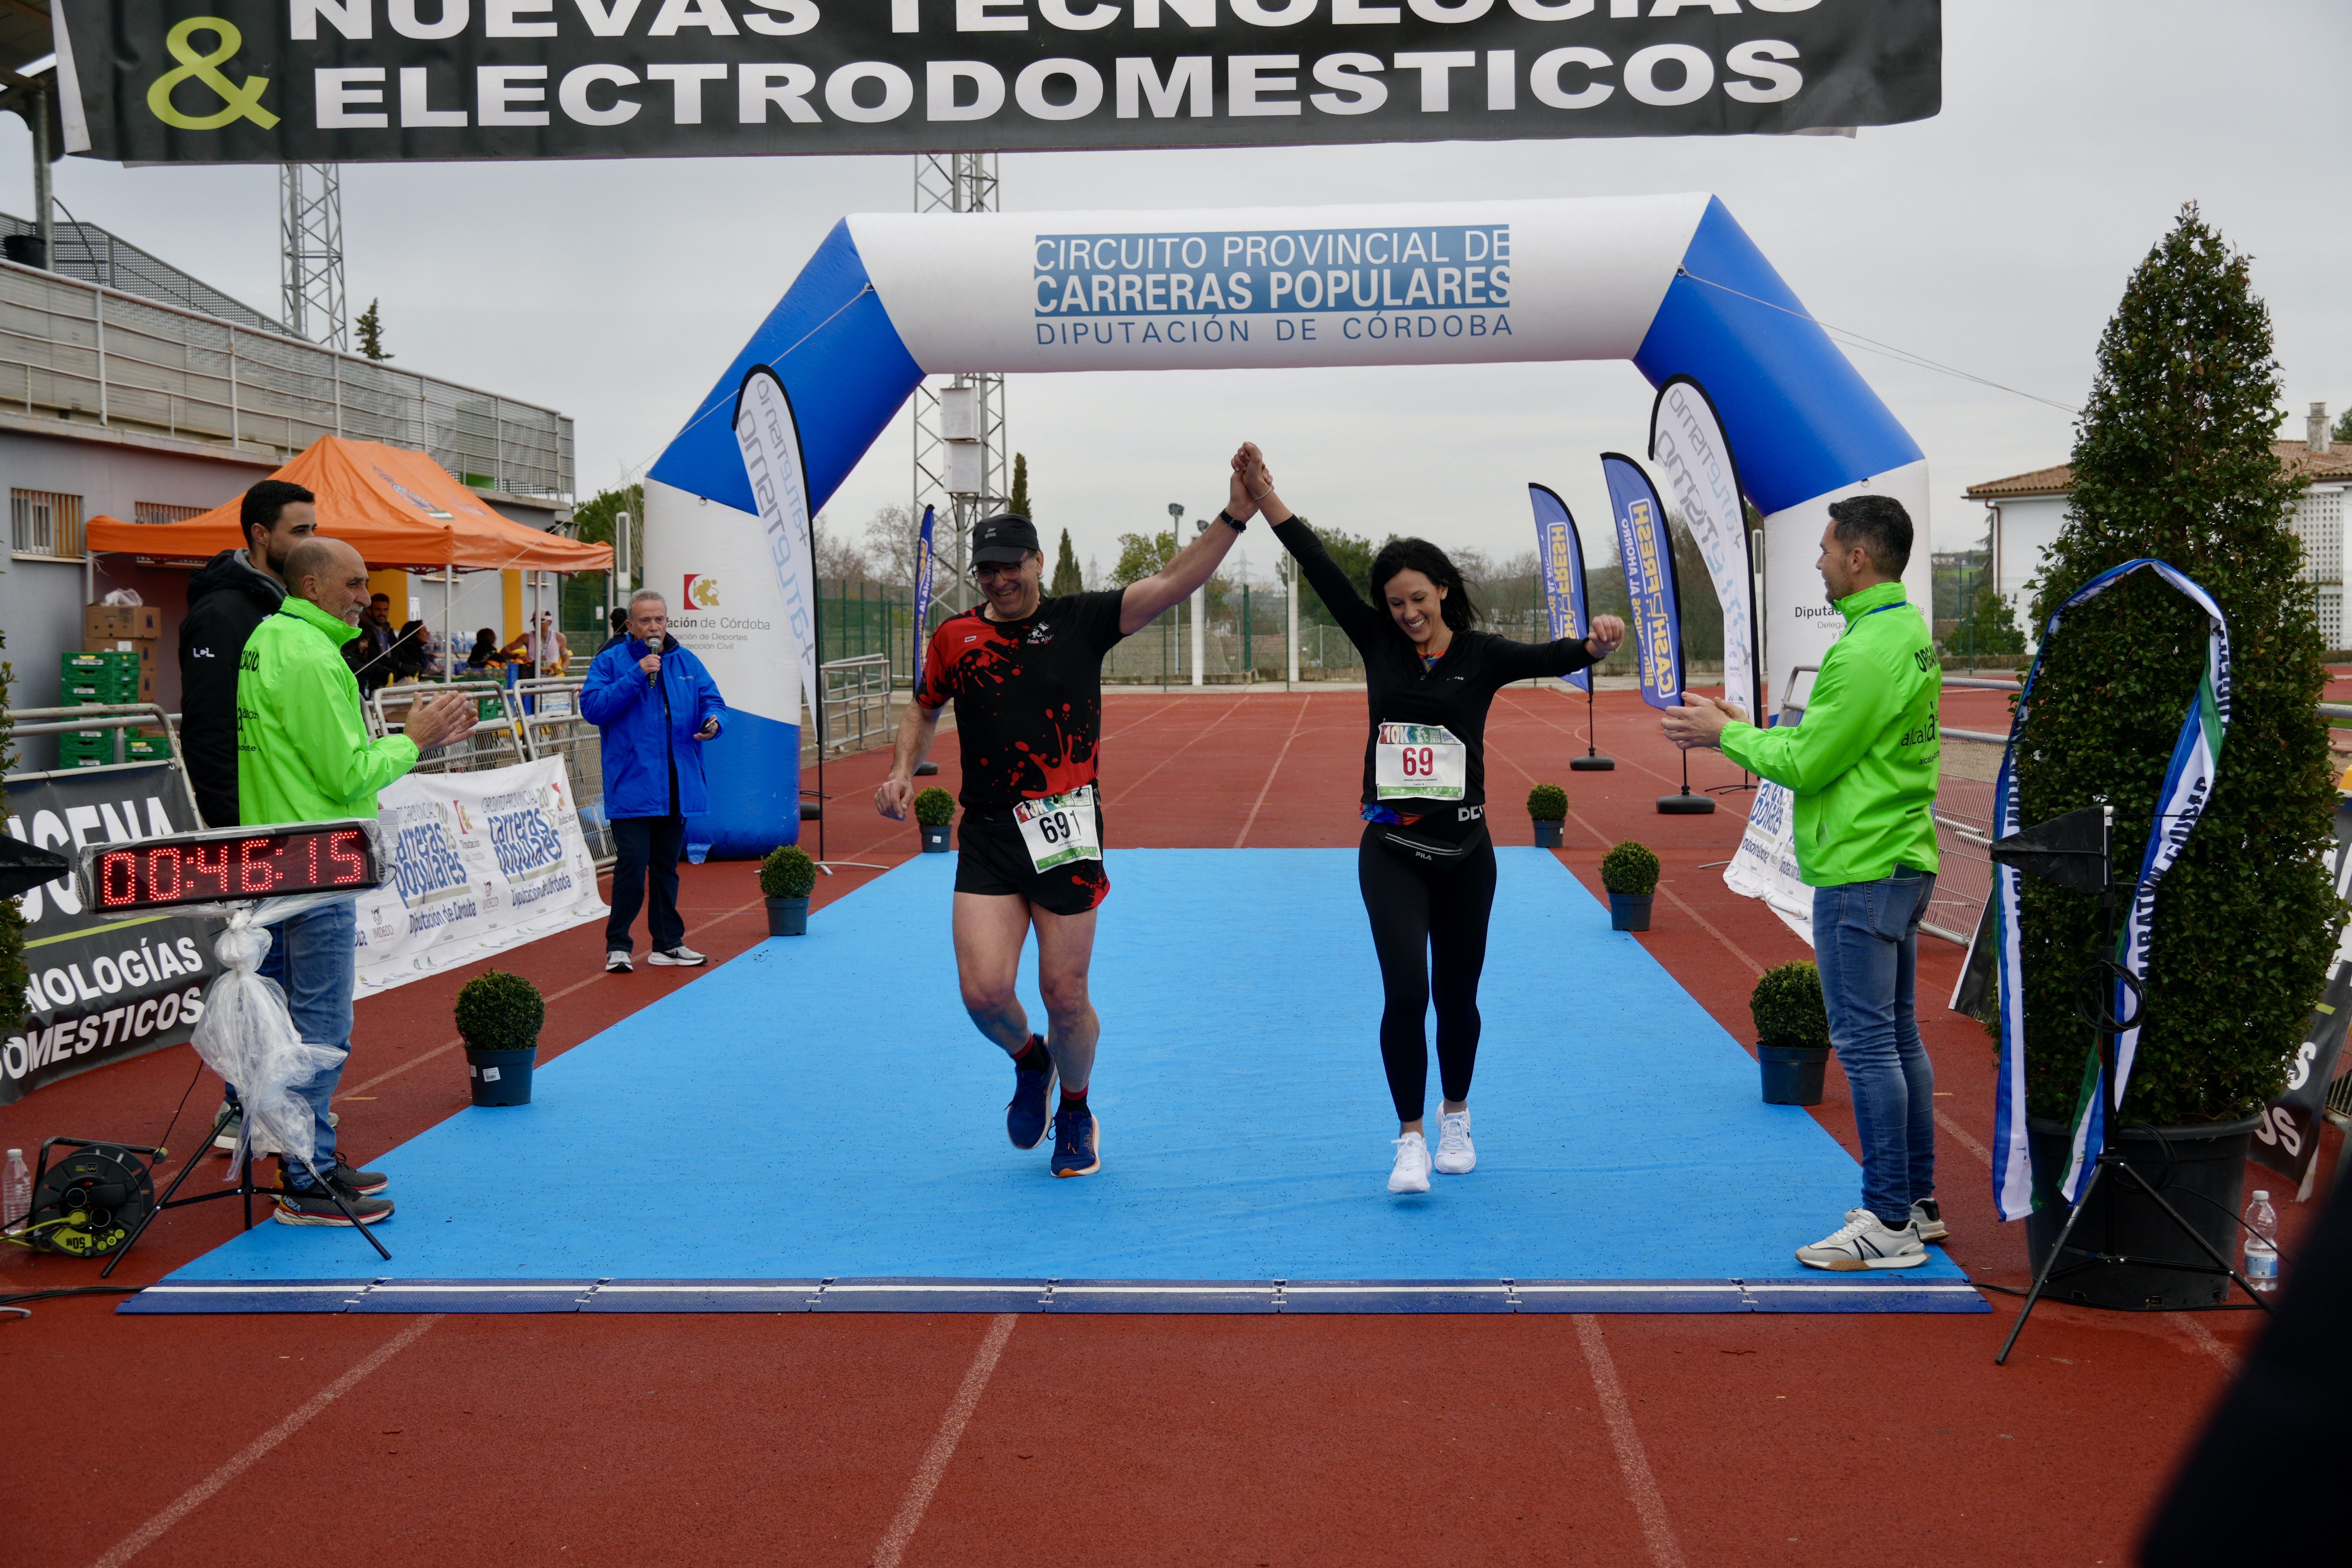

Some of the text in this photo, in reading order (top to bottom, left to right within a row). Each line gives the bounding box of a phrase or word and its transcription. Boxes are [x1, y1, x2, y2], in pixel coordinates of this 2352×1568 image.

[147, 16, 281, 131] &
[315, 40, 1804, 129] ELECTRODOMESTICOS
[1034, 229, 1510, 271] CIRCUITO PROVINCIAL DE
[1034, 266, 1510, 314] CARRERAS POPULARES
[1037, 311, 1513, 345] DIPUTACIÓN DE CÓRDOBA
[700, 617, 716, 628] de
[720, 617, 770, 630] Córdoba
[711, 633, 748, 642] Deportes
[1384, 726, 1410, 744] 10K
[1402, 747, 1433, 776] 69
[436, 801, 448, 824] 20
[487, 808, 549, 846] carreras
[1021, 798, 1049, 820] 10K
[1039, 809, 1082, 844] 691
[395, 822, 447, 865] arreras
[494, 829, 563, 884] populares
[1415, 851, 1432, 861] FILA
[103, 831, 362, 906] 00:46:15
[395, 851, 467, 909] populares
[372, 924, 394, 939] IMDECO
[409, 898, 477, 937] Diputación de Córdoba
[0, 986, 205, 1083] OMESTICOS
[283, 1195, 301, 1212] HOKA
